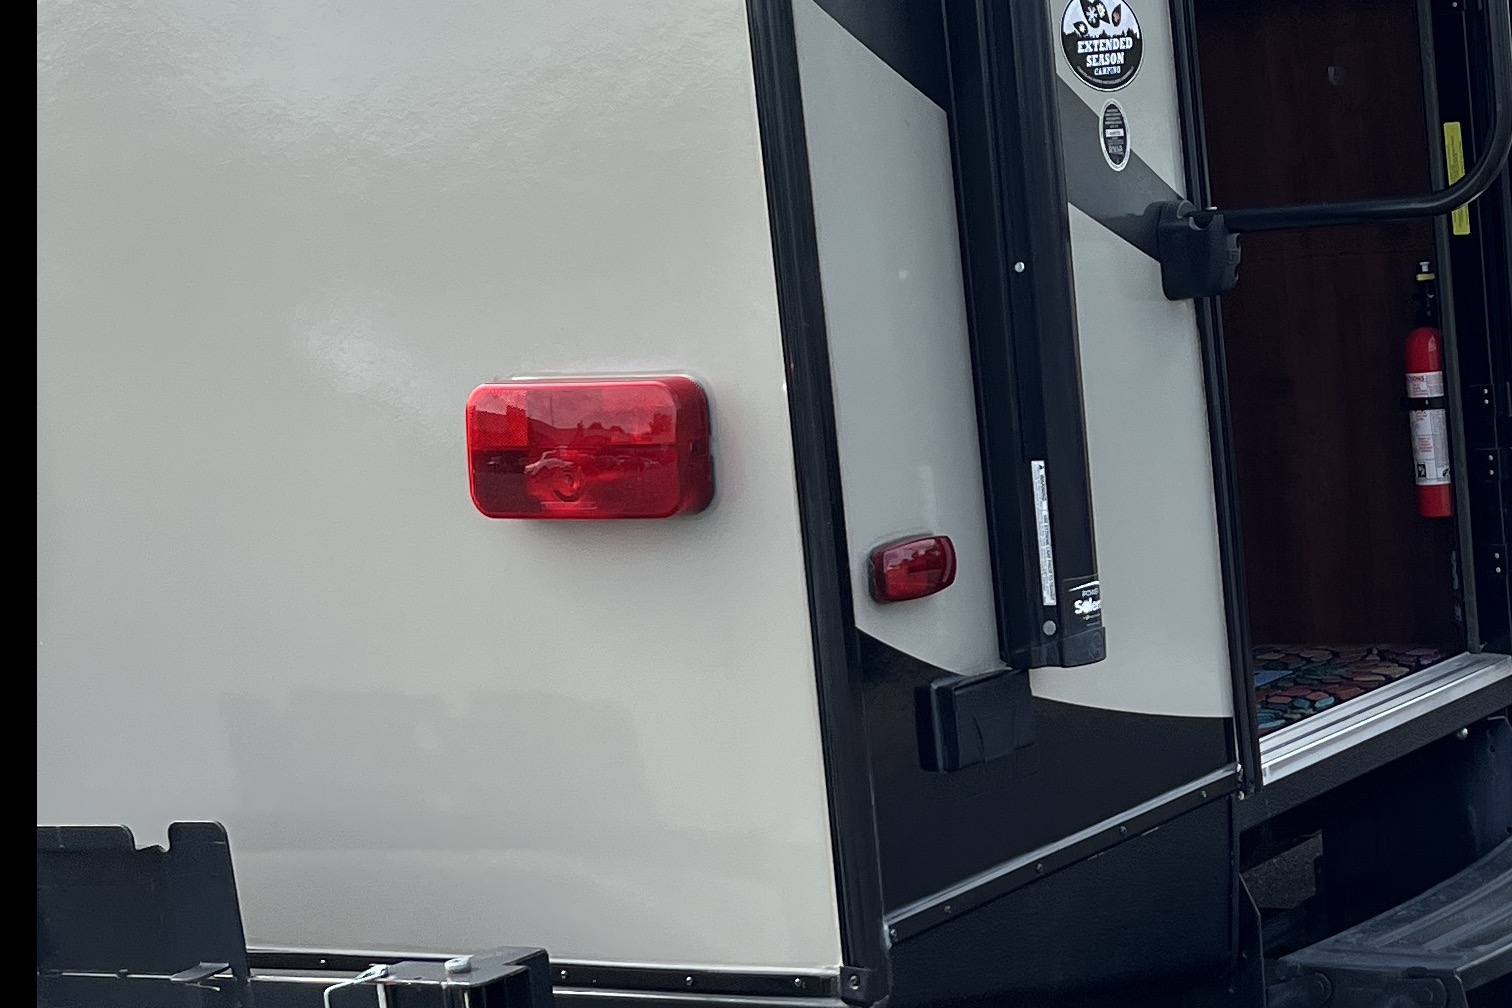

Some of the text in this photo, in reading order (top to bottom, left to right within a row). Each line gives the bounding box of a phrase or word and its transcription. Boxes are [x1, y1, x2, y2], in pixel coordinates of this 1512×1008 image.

[1077, 36, 1133, 54] EXTENDED
[1086, 51, 1125, 68] SEASON
[1094, 65, 1121, 76] CAMPING
